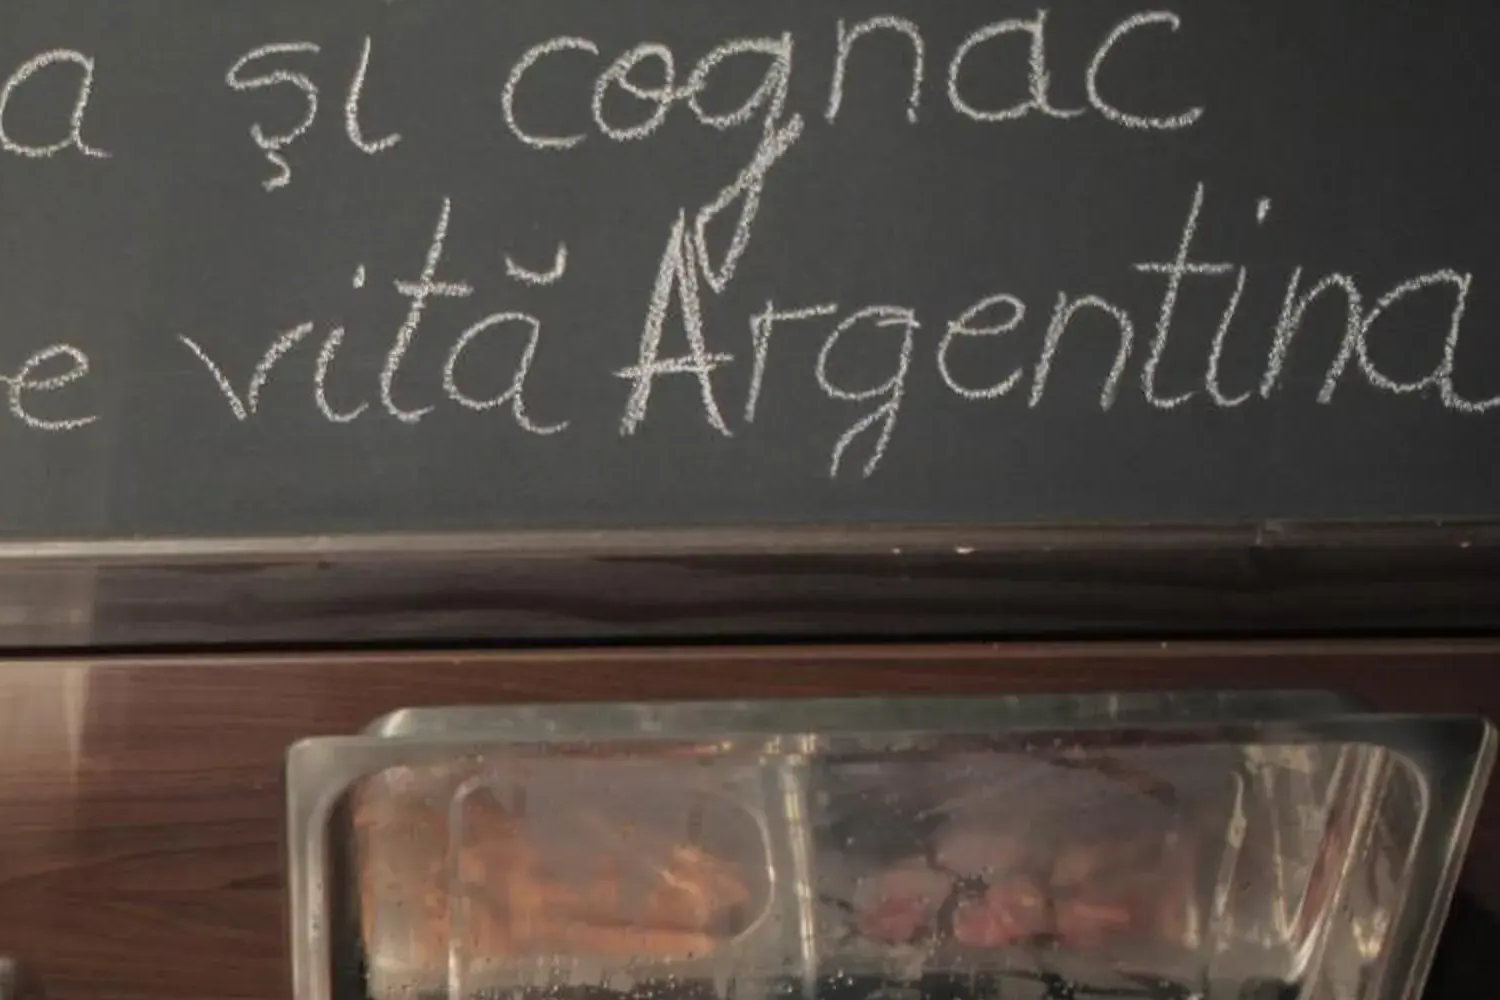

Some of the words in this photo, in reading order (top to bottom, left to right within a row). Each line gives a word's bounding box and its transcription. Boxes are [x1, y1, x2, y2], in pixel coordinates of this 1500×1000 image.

[501, 8, 1203, 294] cognac
[176, 197, 570, 437] vită
[612, 180, 1500, 480] Argentina
